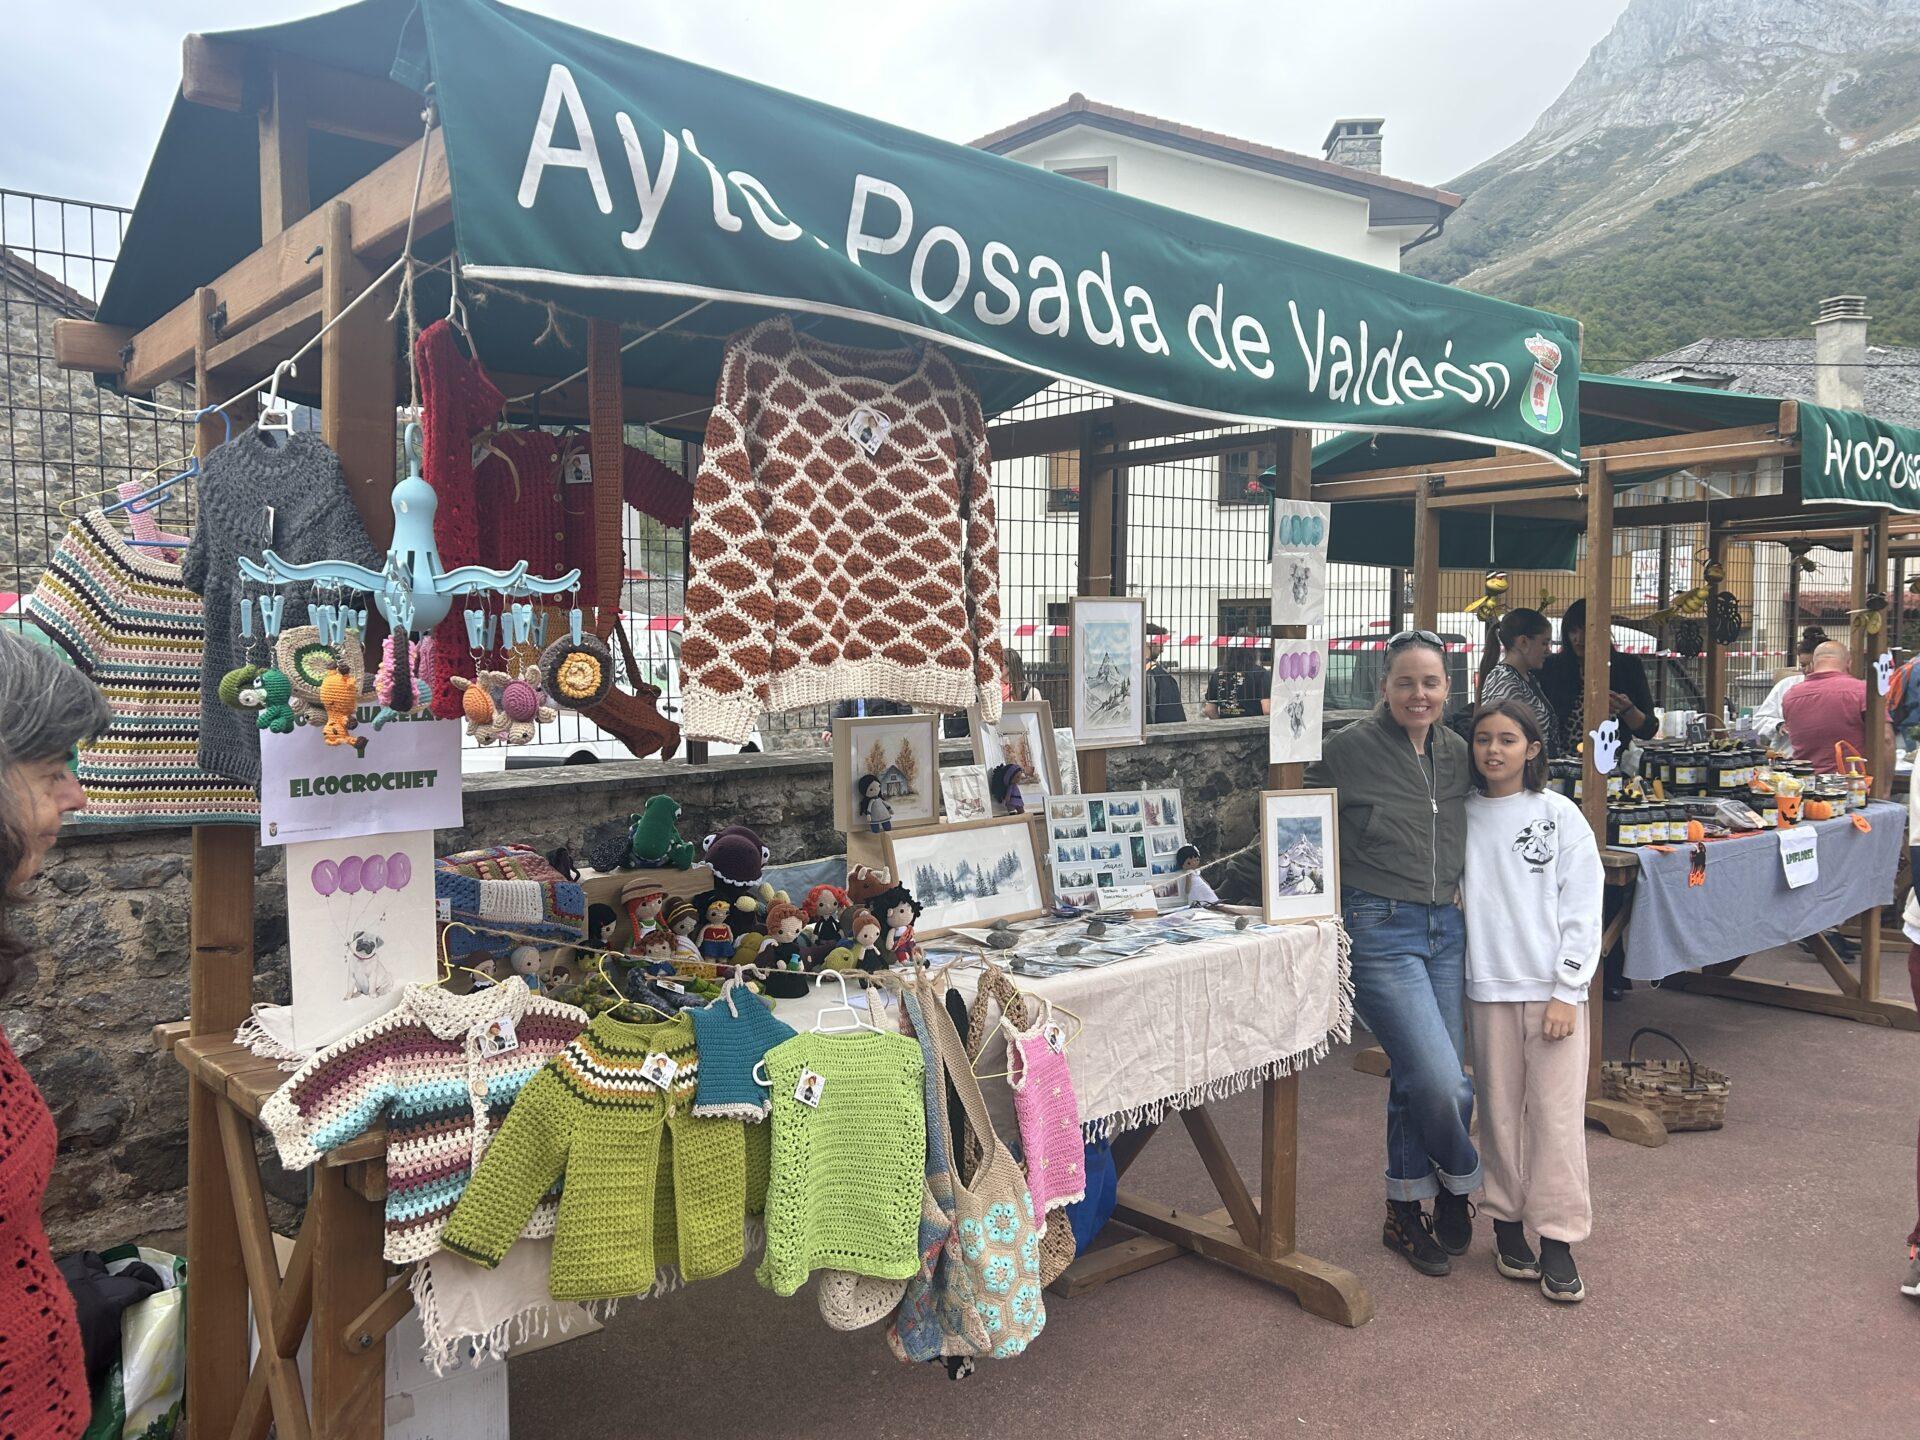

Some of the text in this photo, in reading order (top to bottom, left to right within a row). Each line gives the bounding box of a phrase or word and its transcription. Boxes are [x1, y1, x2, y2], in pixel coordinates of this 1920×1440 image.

[846, 173, 1170, 357] Posada
[1187, 282, 1276, 380] de
[1287, 299, 1511, 411] Valdeón
[289, 769, 438, 798] ELCOCROCHET
